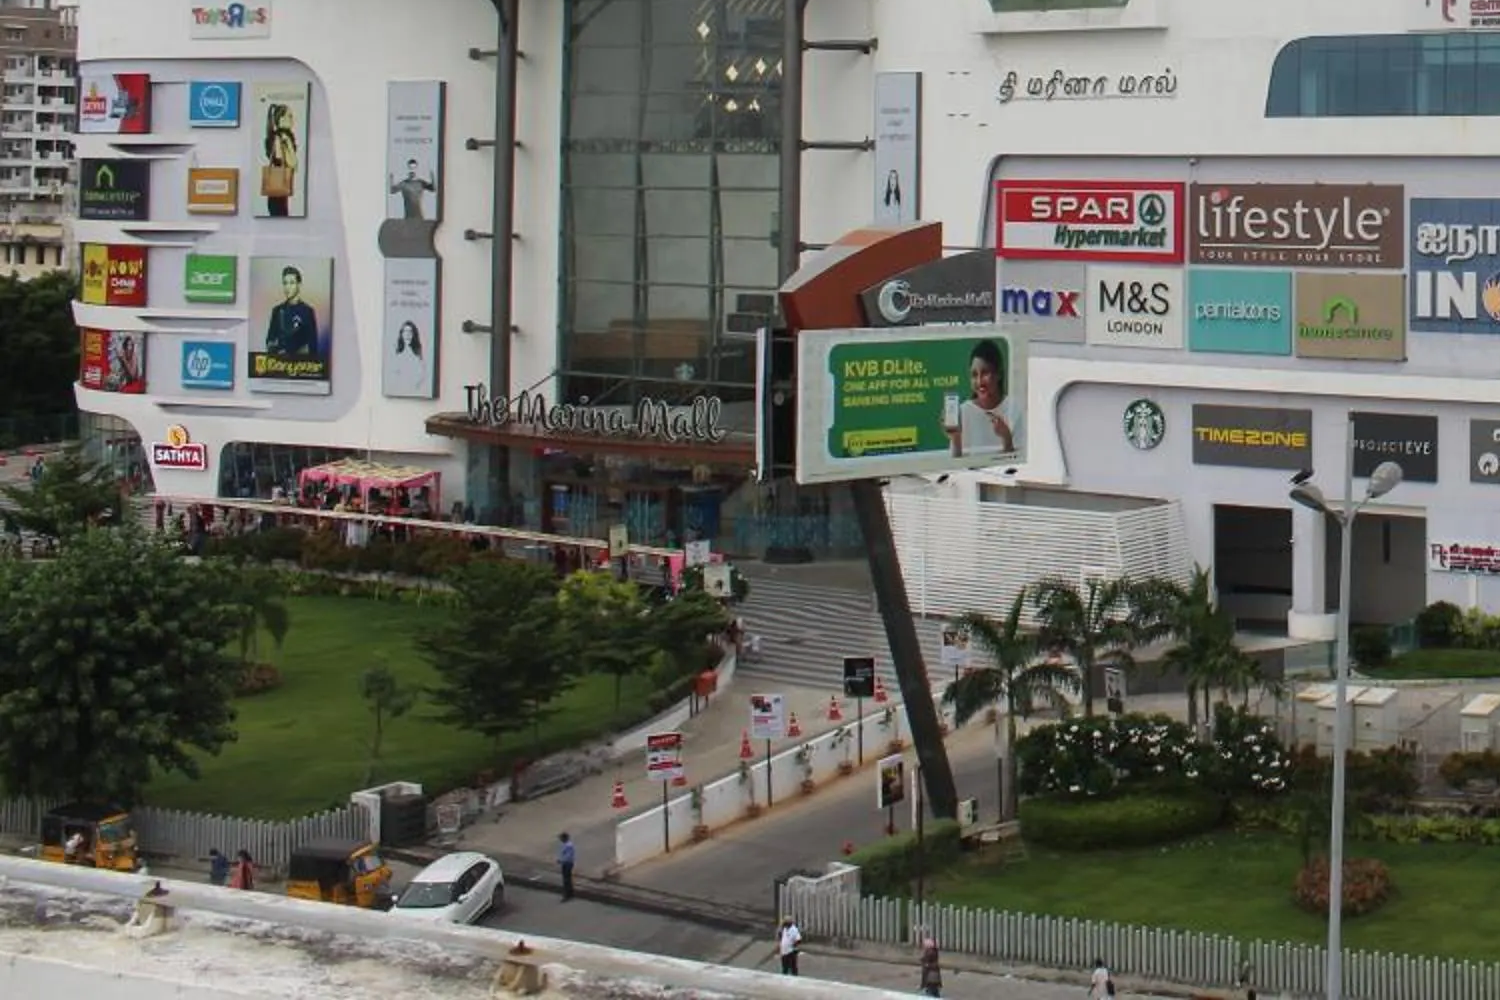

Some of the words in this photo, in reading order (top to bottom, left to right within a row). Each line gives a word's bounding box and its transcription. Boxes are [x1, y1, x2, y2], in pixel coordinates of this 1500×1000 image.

[1118, 67, 1178, 95] மால்
[1031, 195, 1130, 220] SPAR
[1199, 190, 1383, 250] lifestyle
[1054, 225, 1168, 249] Hypermarket
[191, 271, 228, 286] acer
[1002, 285, 1080, 318] max
[1099, 280, 1170, 315] M&S
[1107, 320, 1163, 335] LONDON
[844, 360, 879, 377] KVB
[464, 382, 511, 426] The
[517, 390, 635, 435] Marina
[636, 395, 728, 442] Mall
[1195, 426, 1307, 448] TIMEZONE
[156, 448, 200, 464] SATHYA
